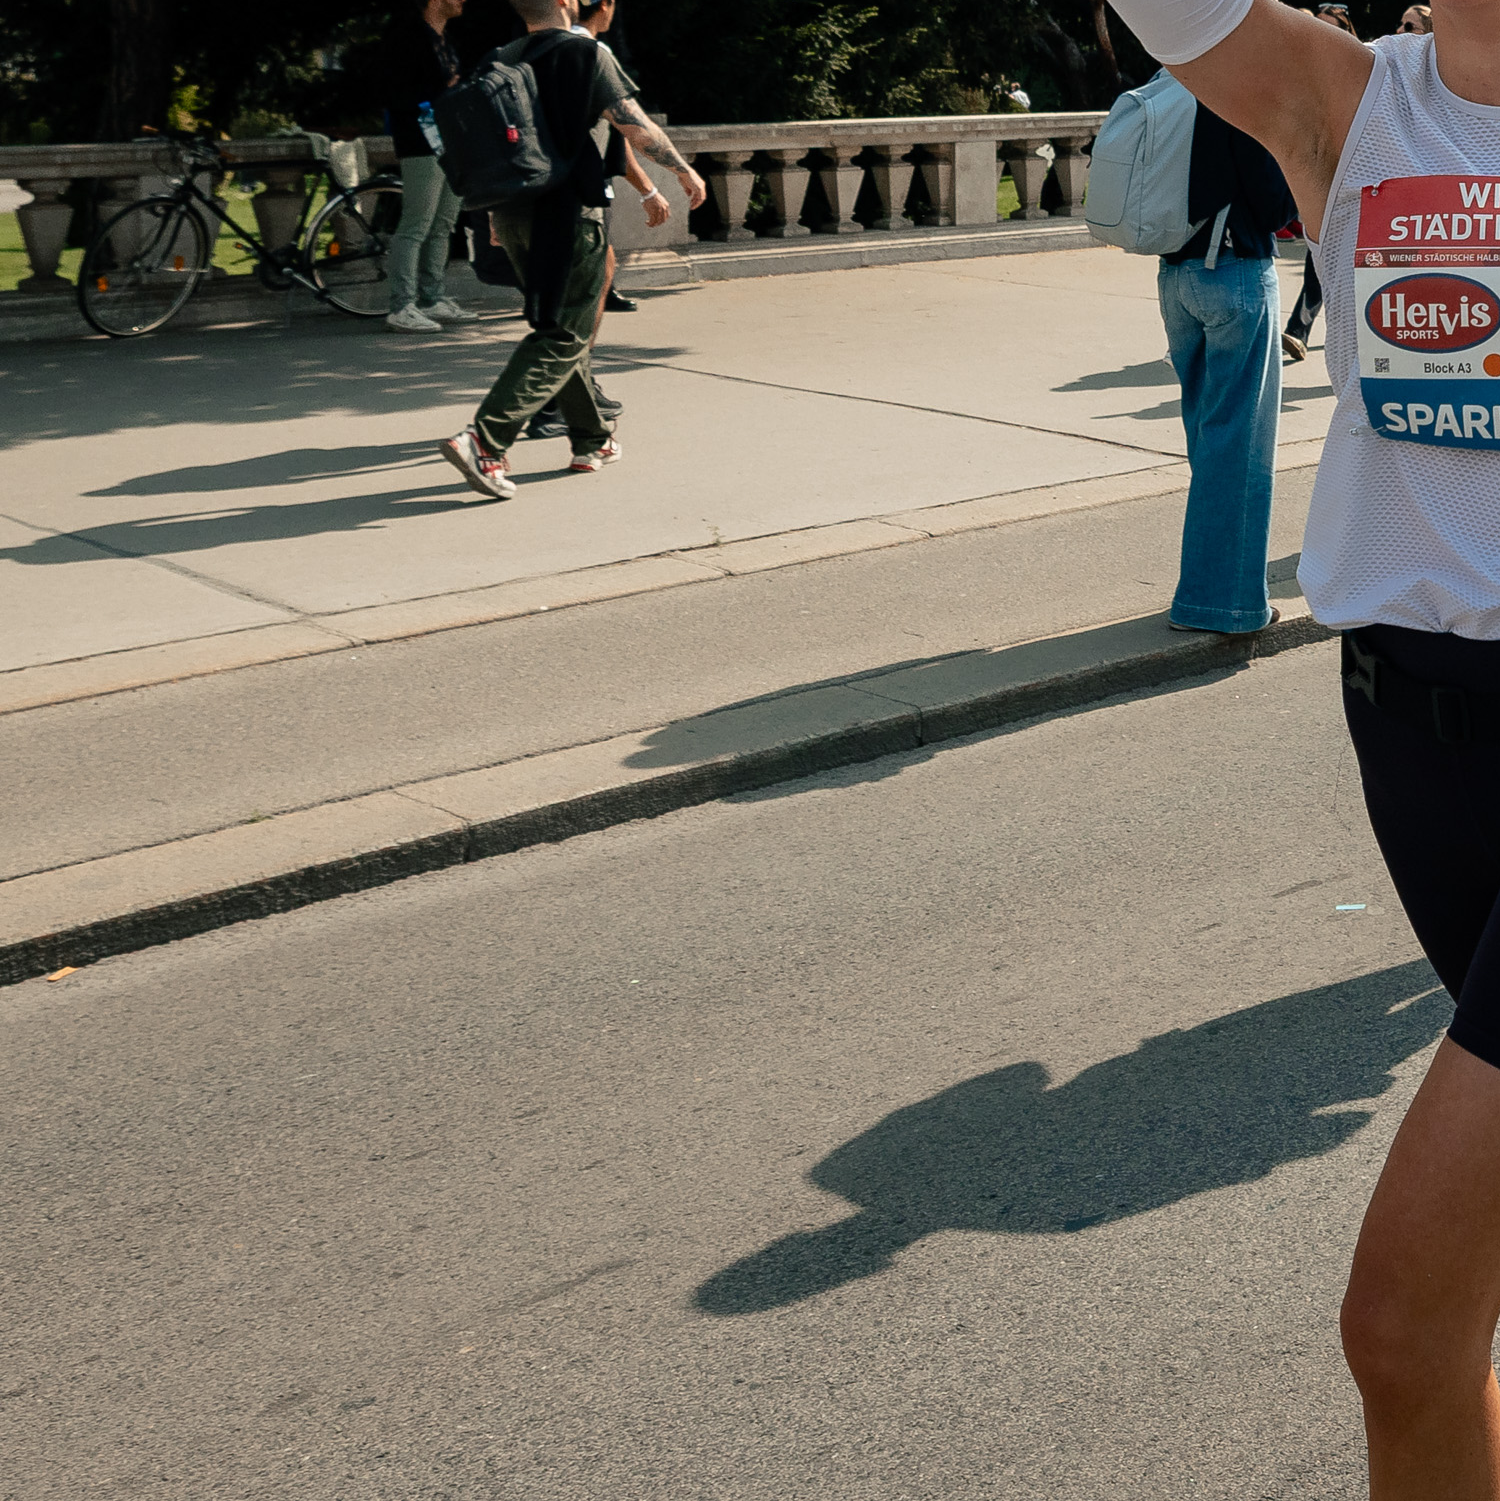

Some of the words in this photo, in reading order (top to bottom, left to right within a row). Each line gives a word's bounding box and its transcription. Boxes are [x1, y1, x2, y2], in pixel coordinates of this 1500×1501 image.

[1389, 254, 1422, 262] WIENER
[1424, 252, 1475, 262] STÄDTISCHE
[1381, 293, 1492, 335] Hervis
[1396, 330, 1440, 341] SPORTS
[1424, 362, 1454, 374] Block
[1457, 362, 1472, 374] A3
